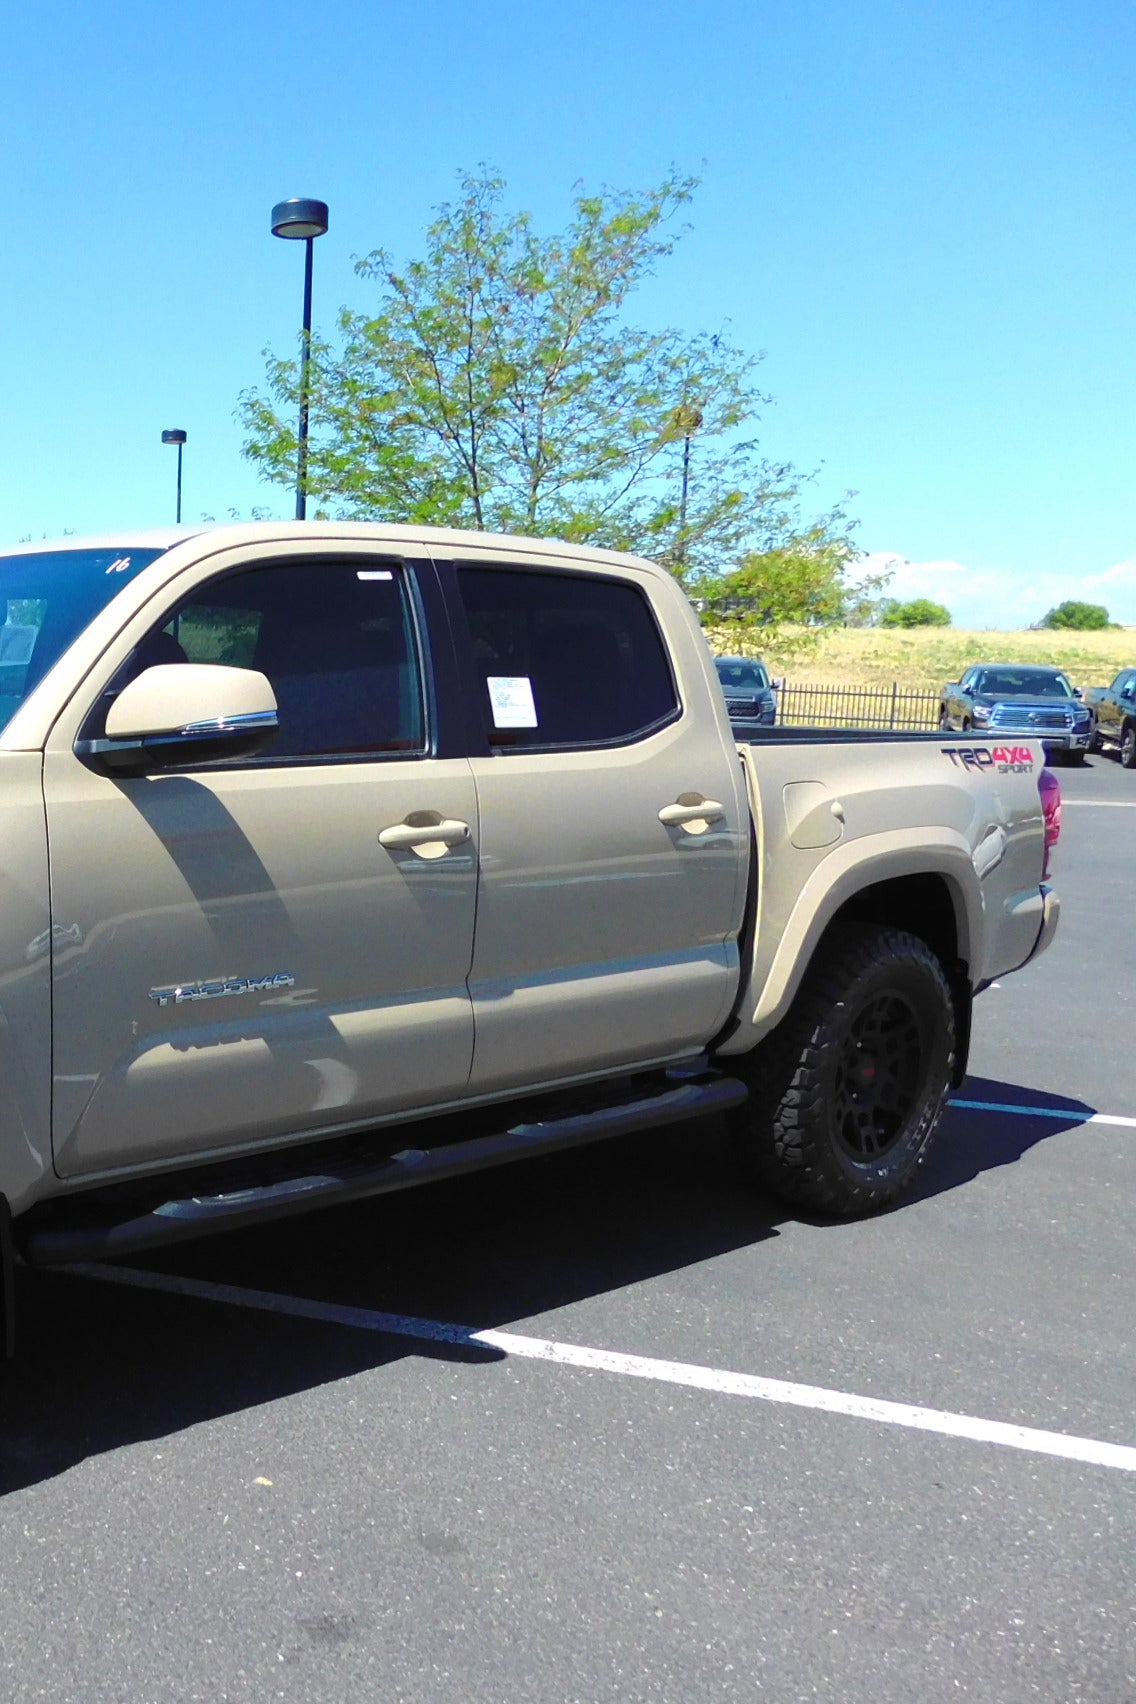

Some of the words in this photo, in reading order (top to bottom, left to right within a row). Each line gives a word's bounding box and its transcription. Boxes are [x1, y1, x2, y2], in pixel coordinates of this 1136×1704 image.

[941, 747, 994, 772] TRD
[997, 764, 1034, 774] SPORT
[149, 972, 295, 1006] TACOMA
